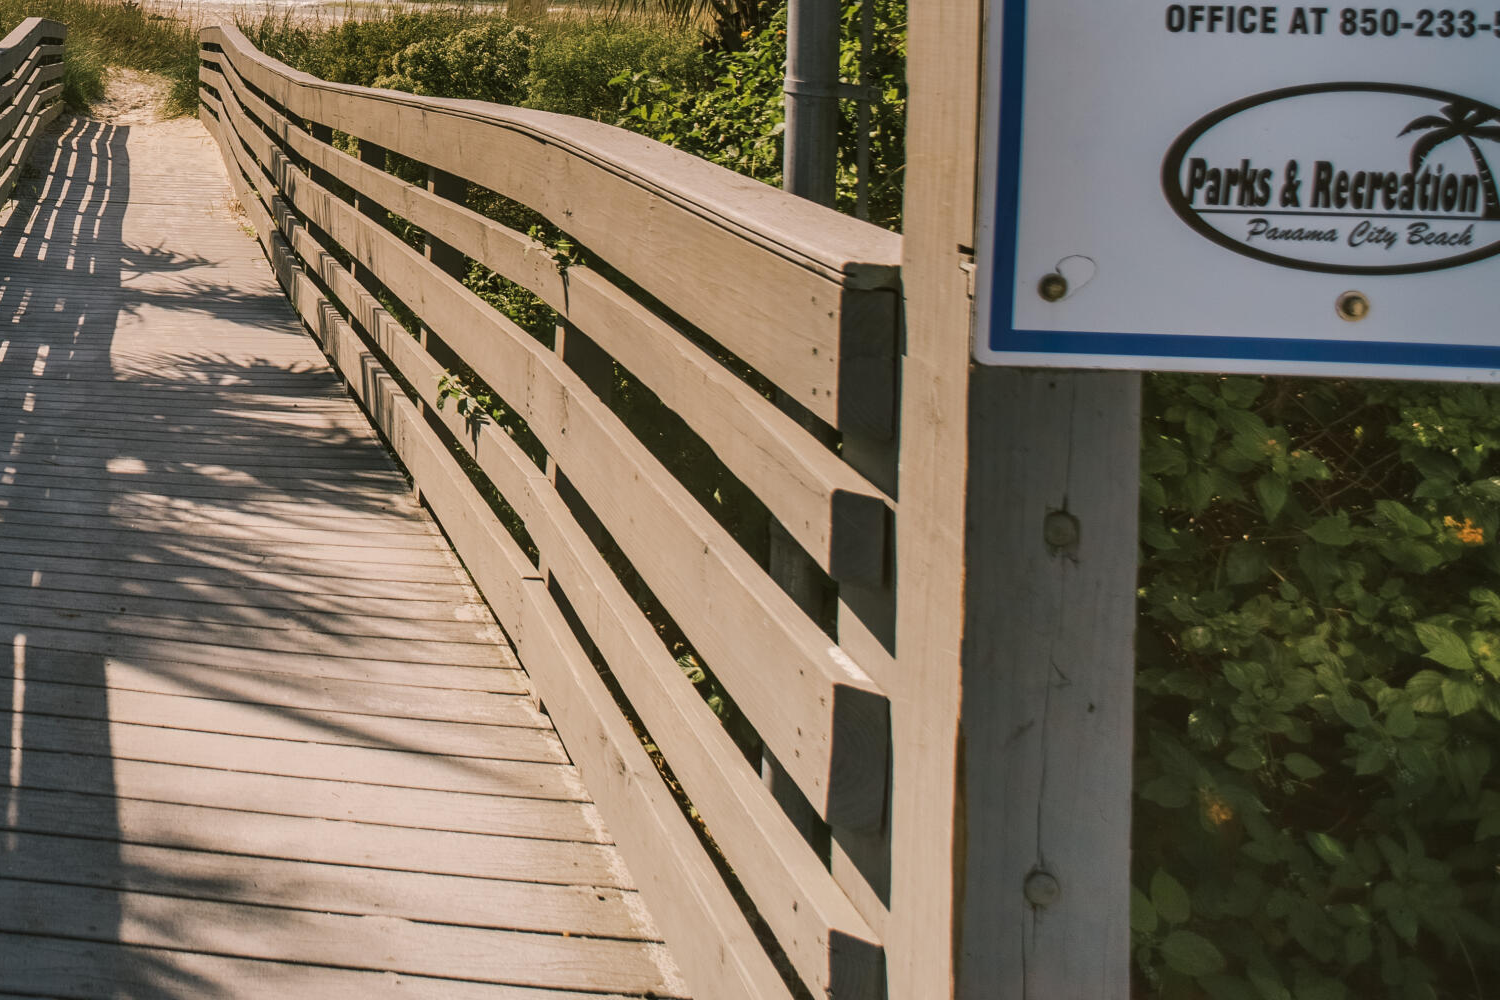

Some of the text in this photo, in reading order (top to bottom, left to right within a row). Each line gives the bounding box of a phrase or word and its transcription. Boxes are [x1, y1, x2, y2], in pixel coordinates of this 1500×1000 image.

[1185, 158, 1479, 212] Parks & Recreation
[1246, 217, 1477, 249] Panama City Beach
